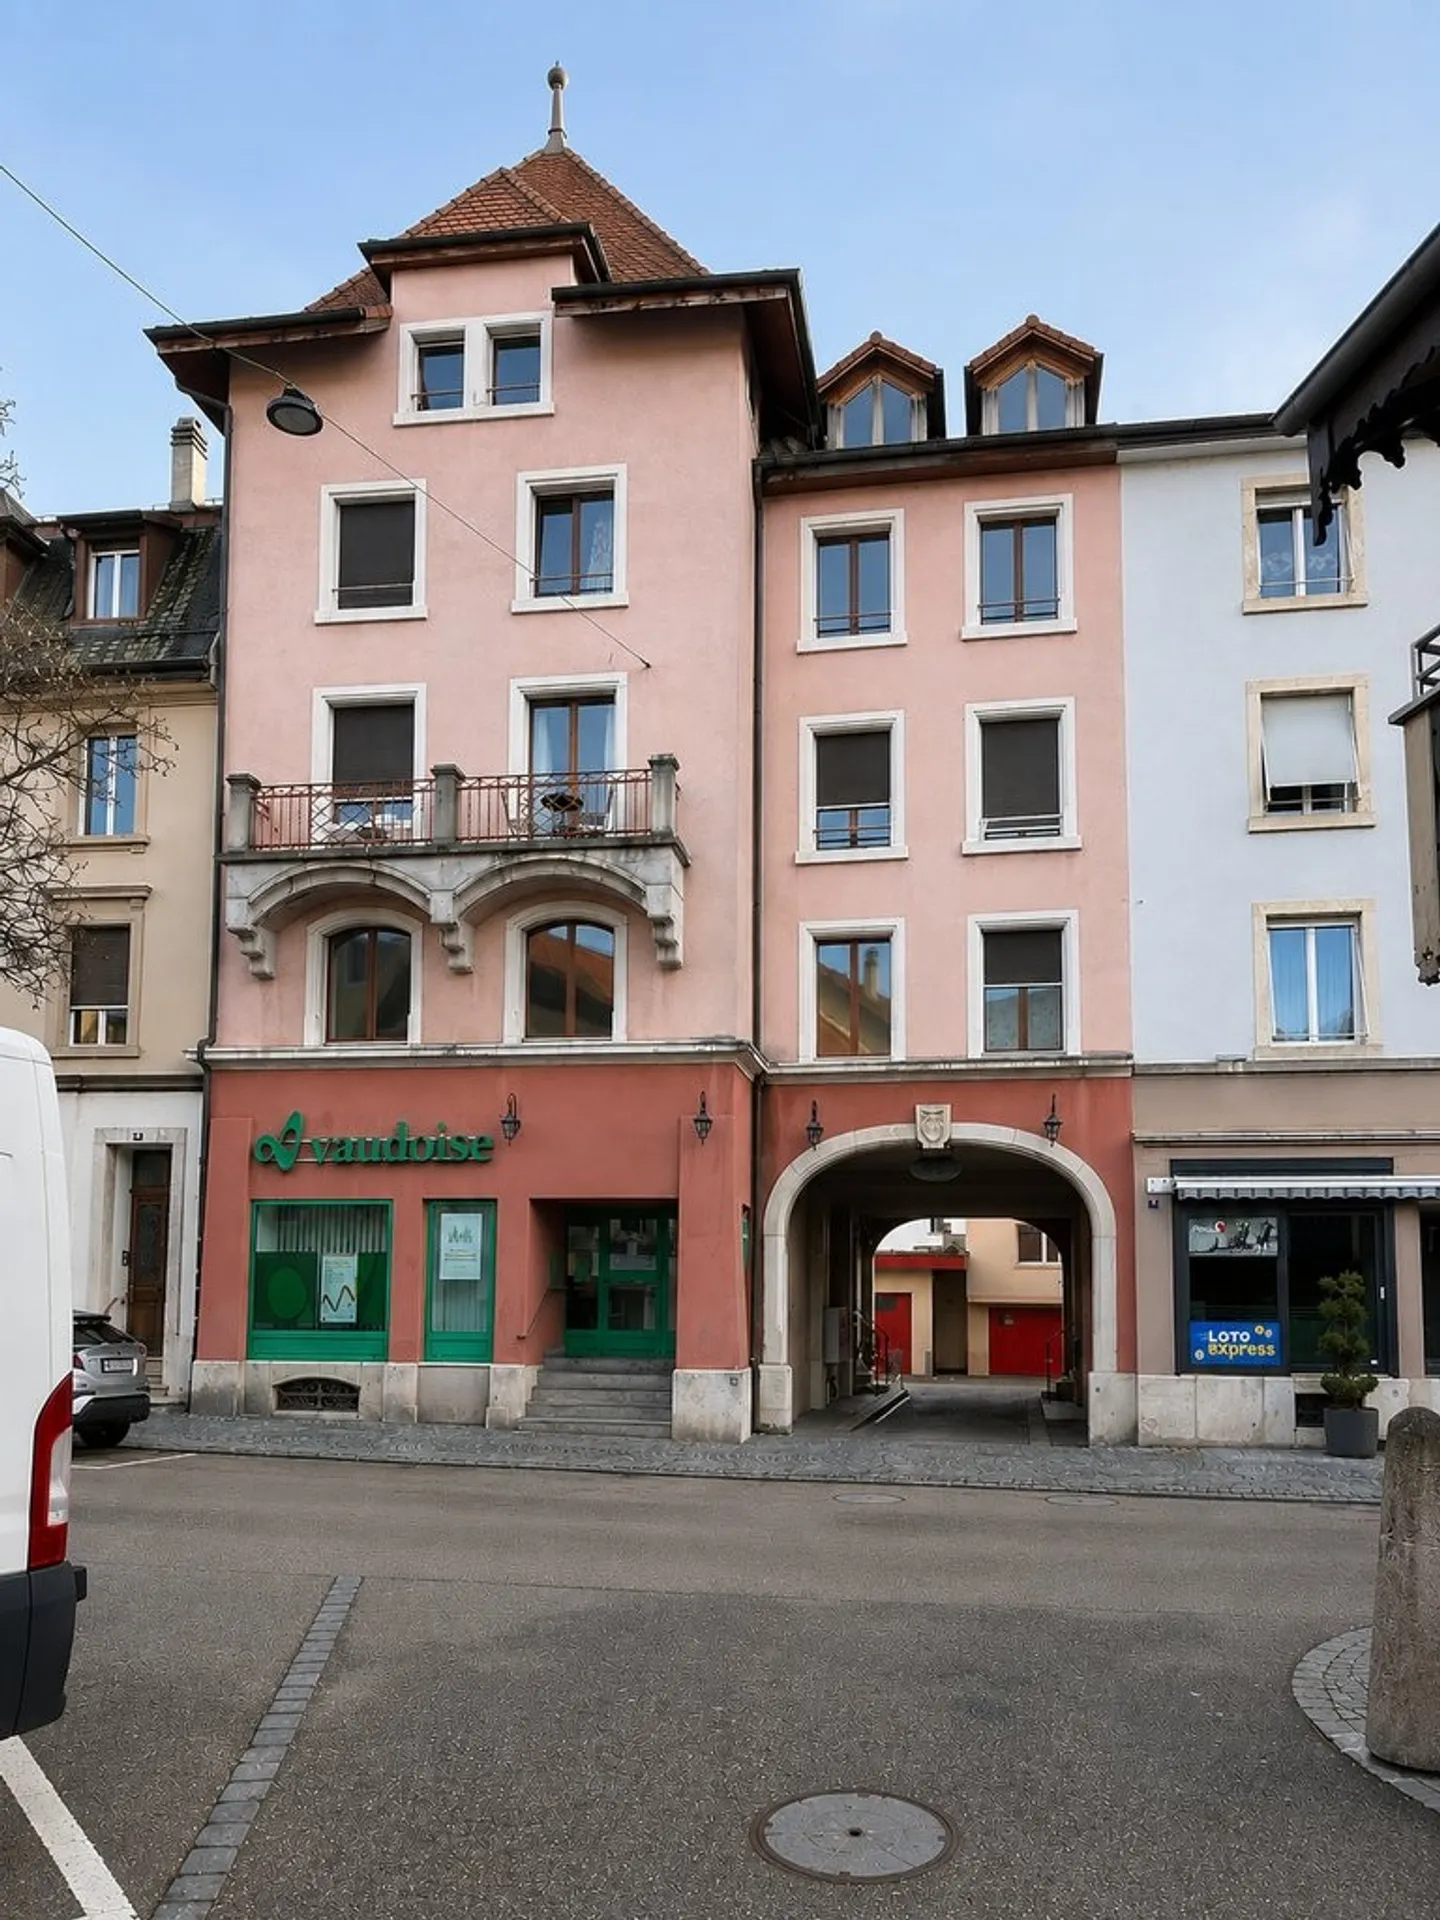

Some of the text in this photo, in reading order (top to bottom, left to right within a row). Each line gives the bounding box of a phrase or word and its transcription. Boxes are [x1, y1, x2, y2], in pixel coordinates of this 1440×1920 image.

[311, 1121, 494, 1164] vaudoise
[1208, 1330, 1251, 1343] LOTO
[1208, 1344, 1276, 1360] express
